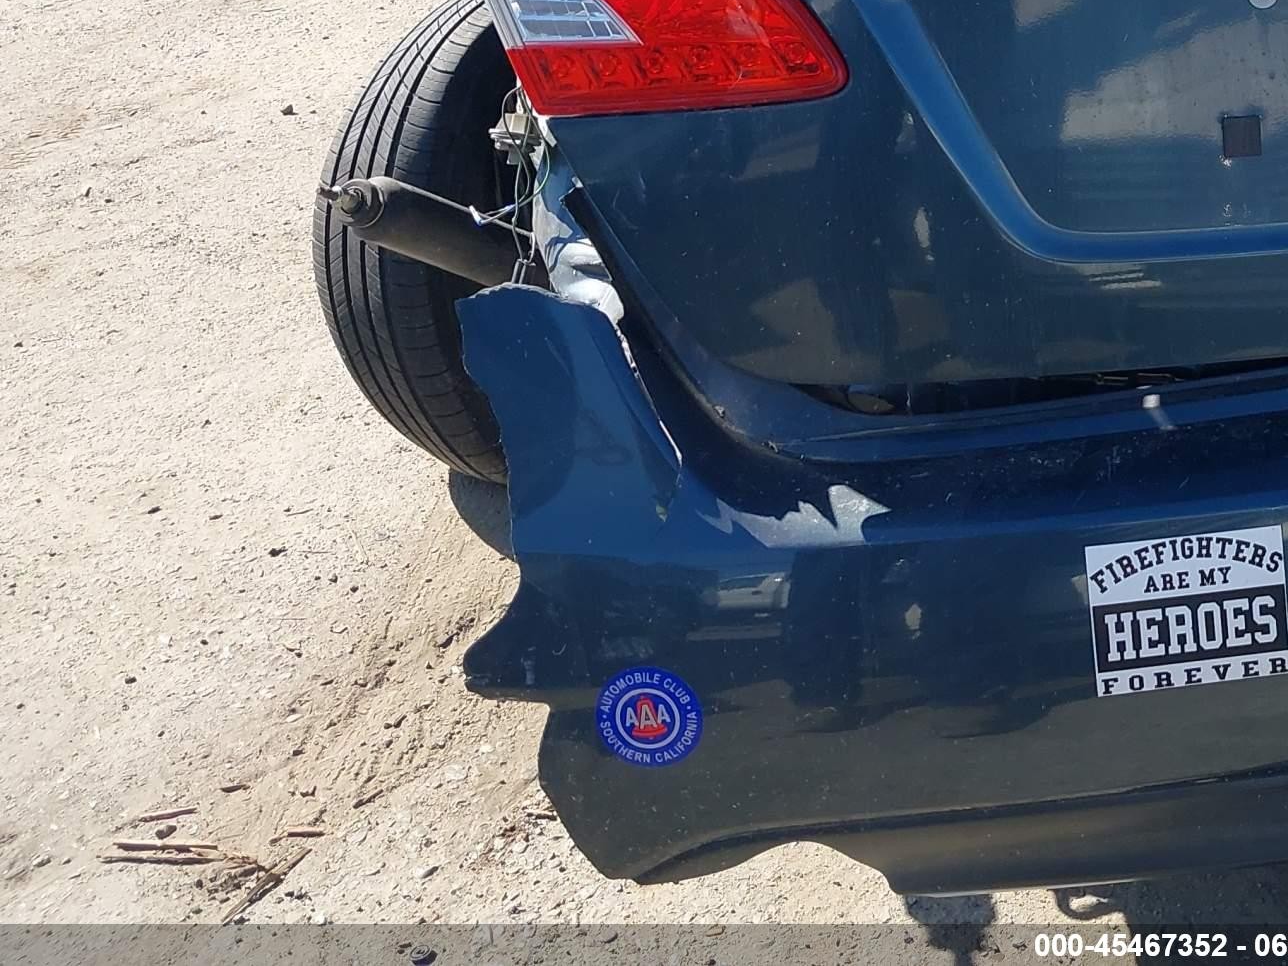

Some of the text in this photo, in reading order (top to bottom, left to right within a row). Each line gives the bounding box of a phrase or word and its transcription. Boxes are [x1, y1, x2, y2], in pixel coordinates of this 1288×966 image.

[1090, 536, 1283, 594] FIREFIGHTERS
[1144, 566, 1232, 594] ARE MY
[1104, 595, 1278, 663] HEROES
[600, 672, 691, 713] AUTOMOBILE CLUB
[1101, 657, 1288, 695] FOREVER
[600, 711, 698, 763] SOUTHERN CALIFORNIA
[625, 704, 671, 729] AAA
